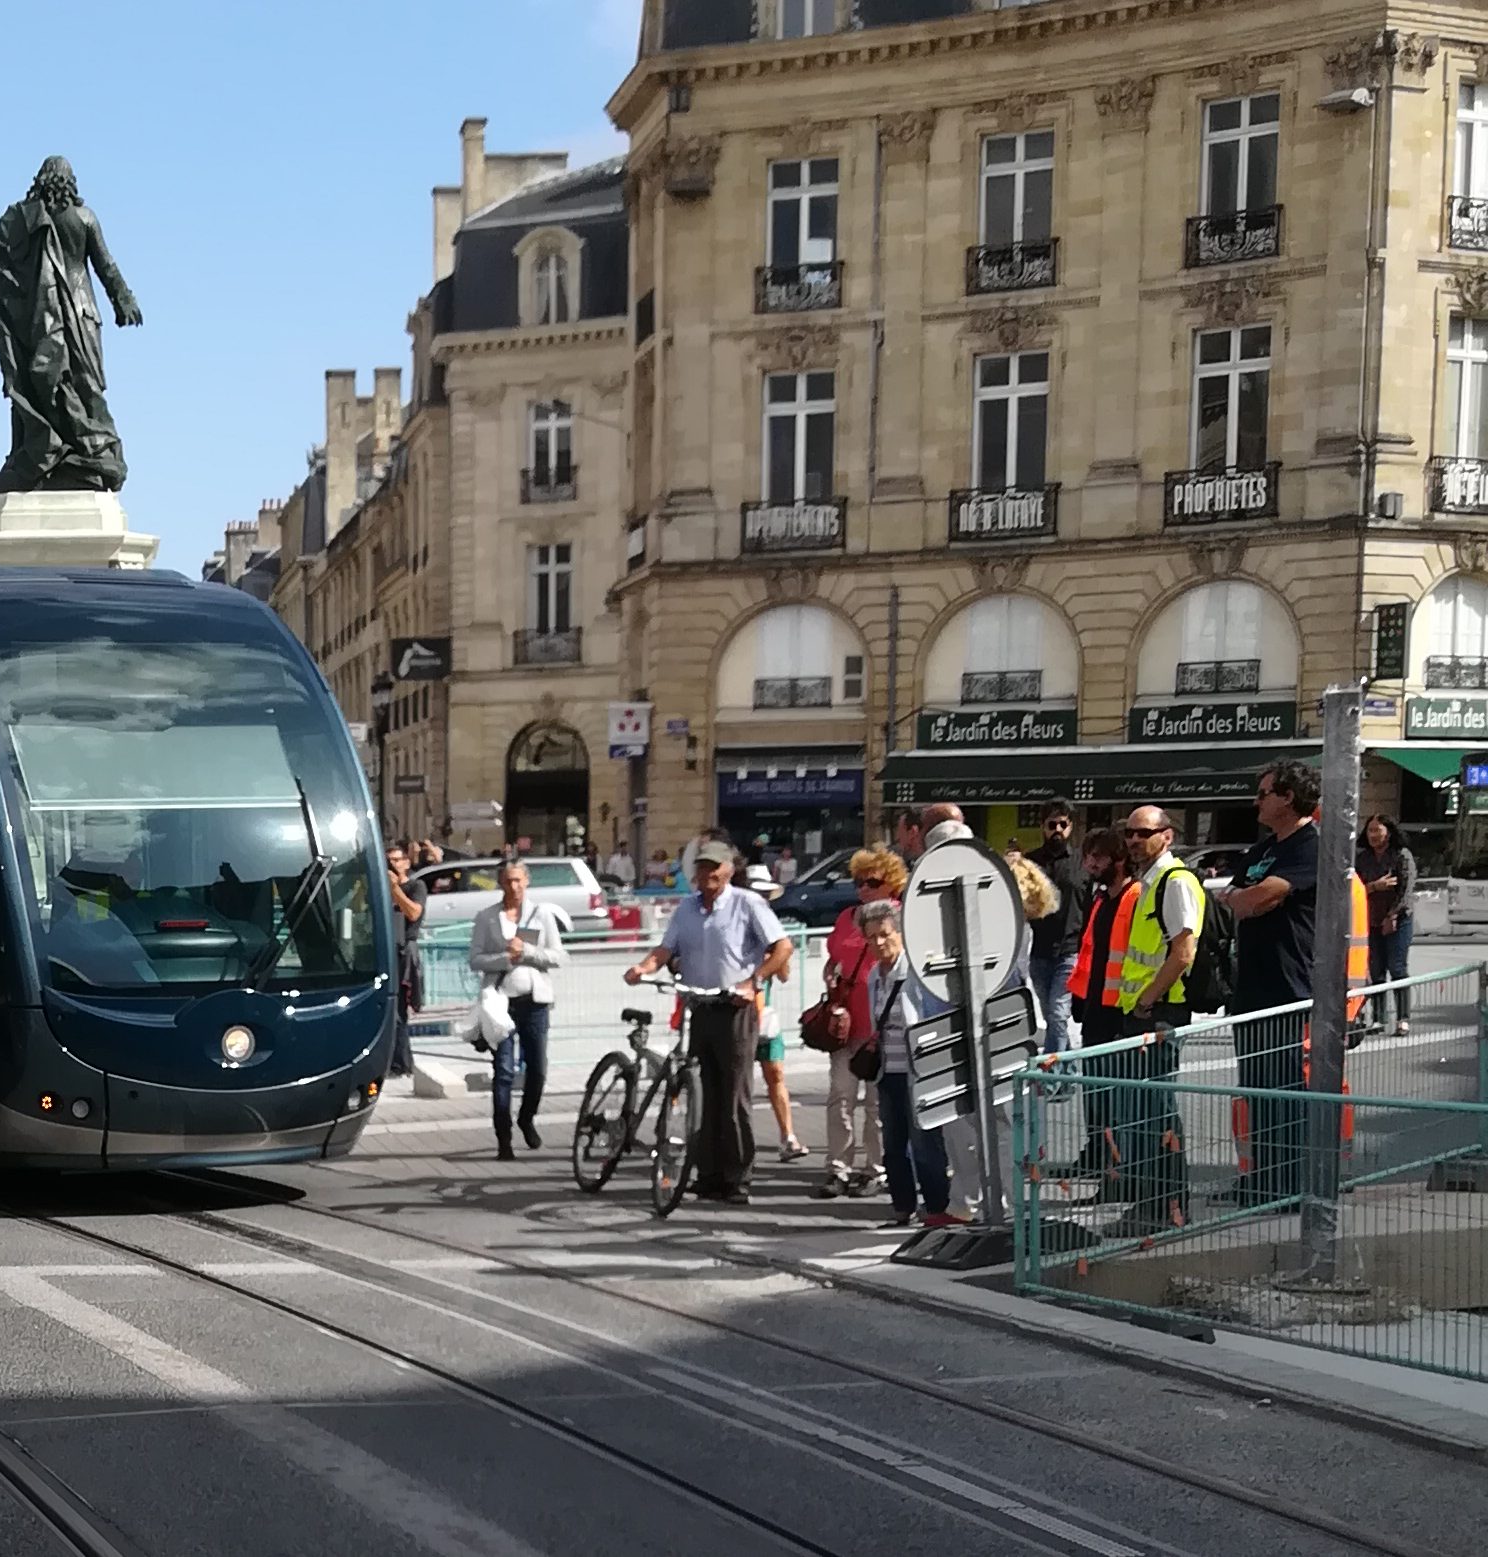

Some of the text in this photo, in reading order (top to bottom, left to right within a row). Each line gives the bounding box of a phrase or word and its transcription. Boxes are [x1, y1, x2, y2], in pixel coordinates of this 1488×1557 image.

[1142, 713, 1281, 736] le Jardin des Fleurs
[1411, 706, 1423, 728] le
[1424, 706, 1462, 728] Jardin
[1463, 706, 1485, 728] des
[930, 719, 1064, 743] le Jardin des Fleurs
